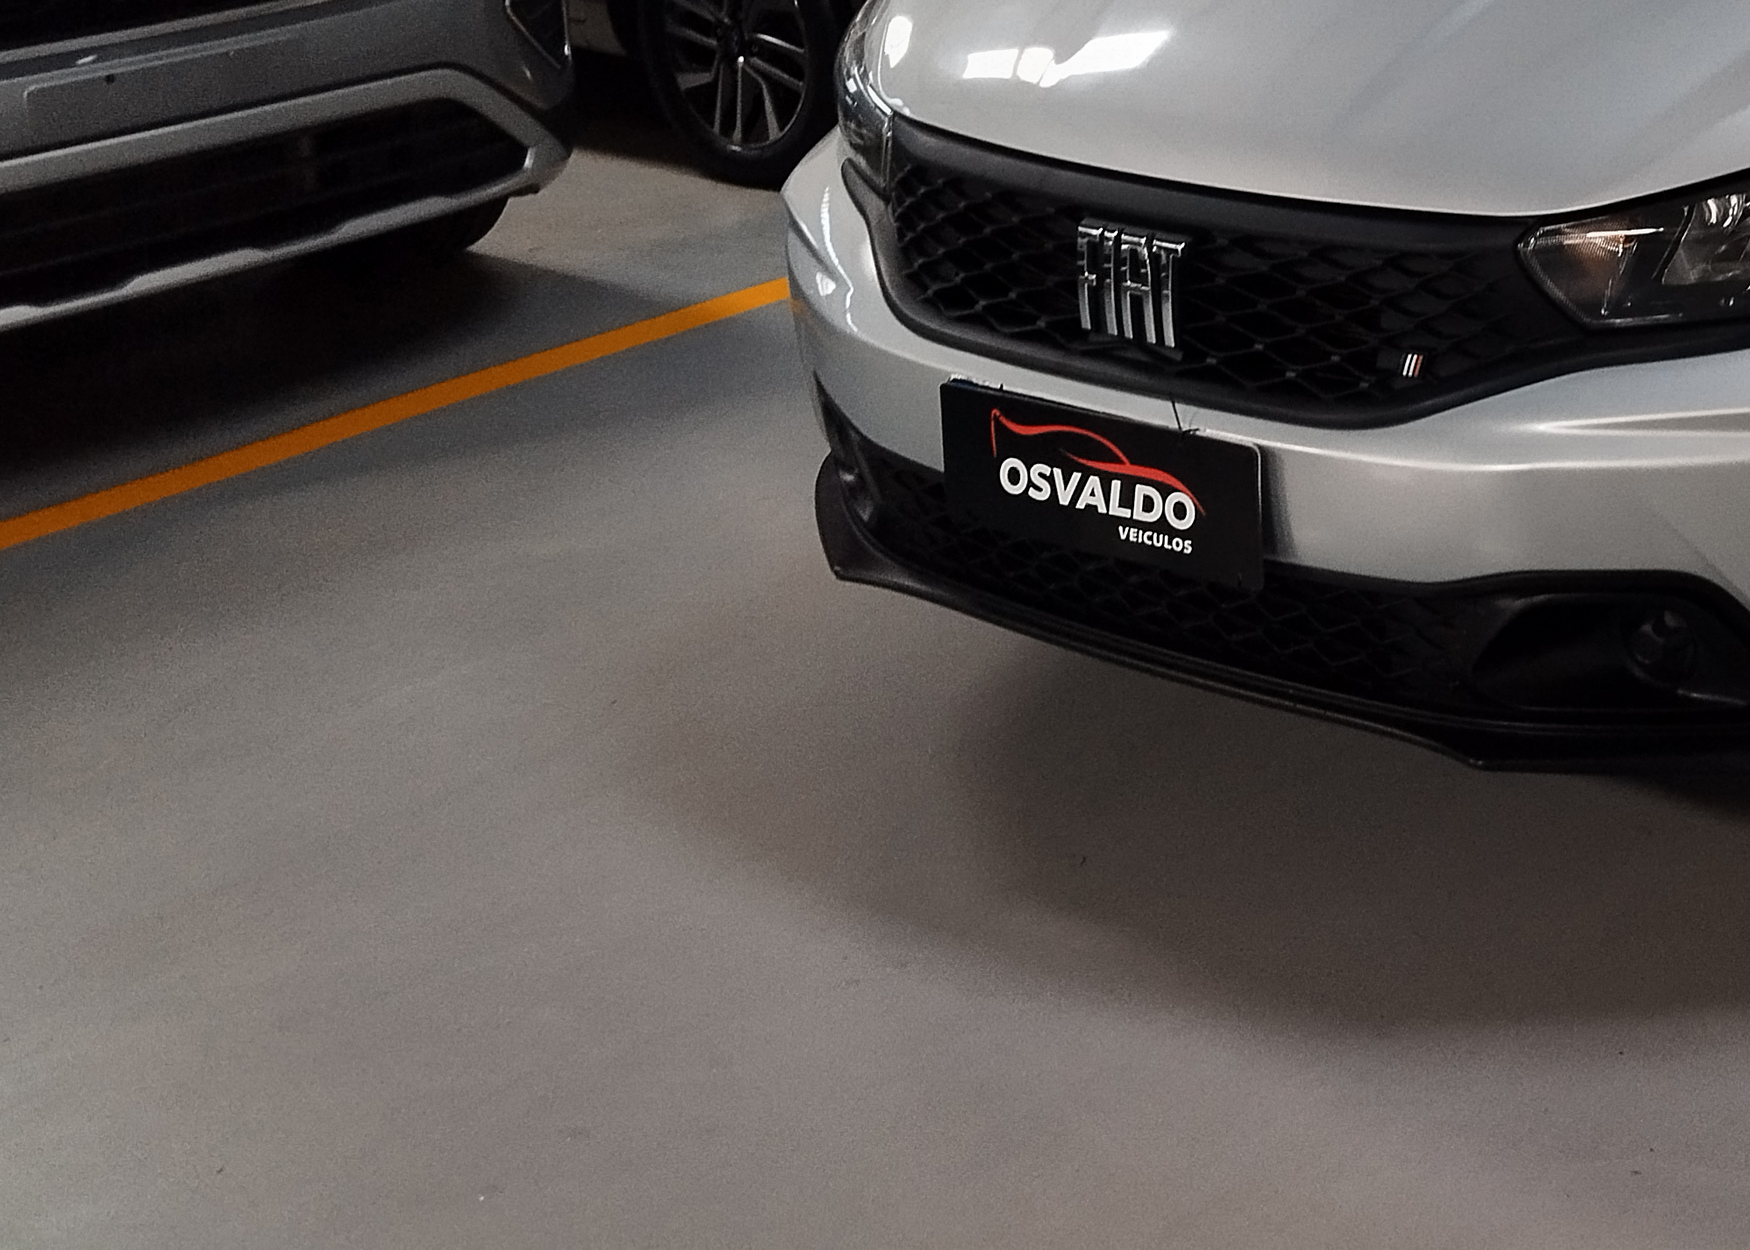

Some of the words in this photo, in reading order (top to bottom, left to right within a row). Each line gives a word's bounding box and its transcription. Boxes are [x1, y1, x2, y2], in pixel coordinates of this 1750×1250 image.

[1076, 223, 1187, 349] FIAT
[999, 457, 1197, 532] OSVALDO
[1118, 524, 1194, 555] VEICULOS
